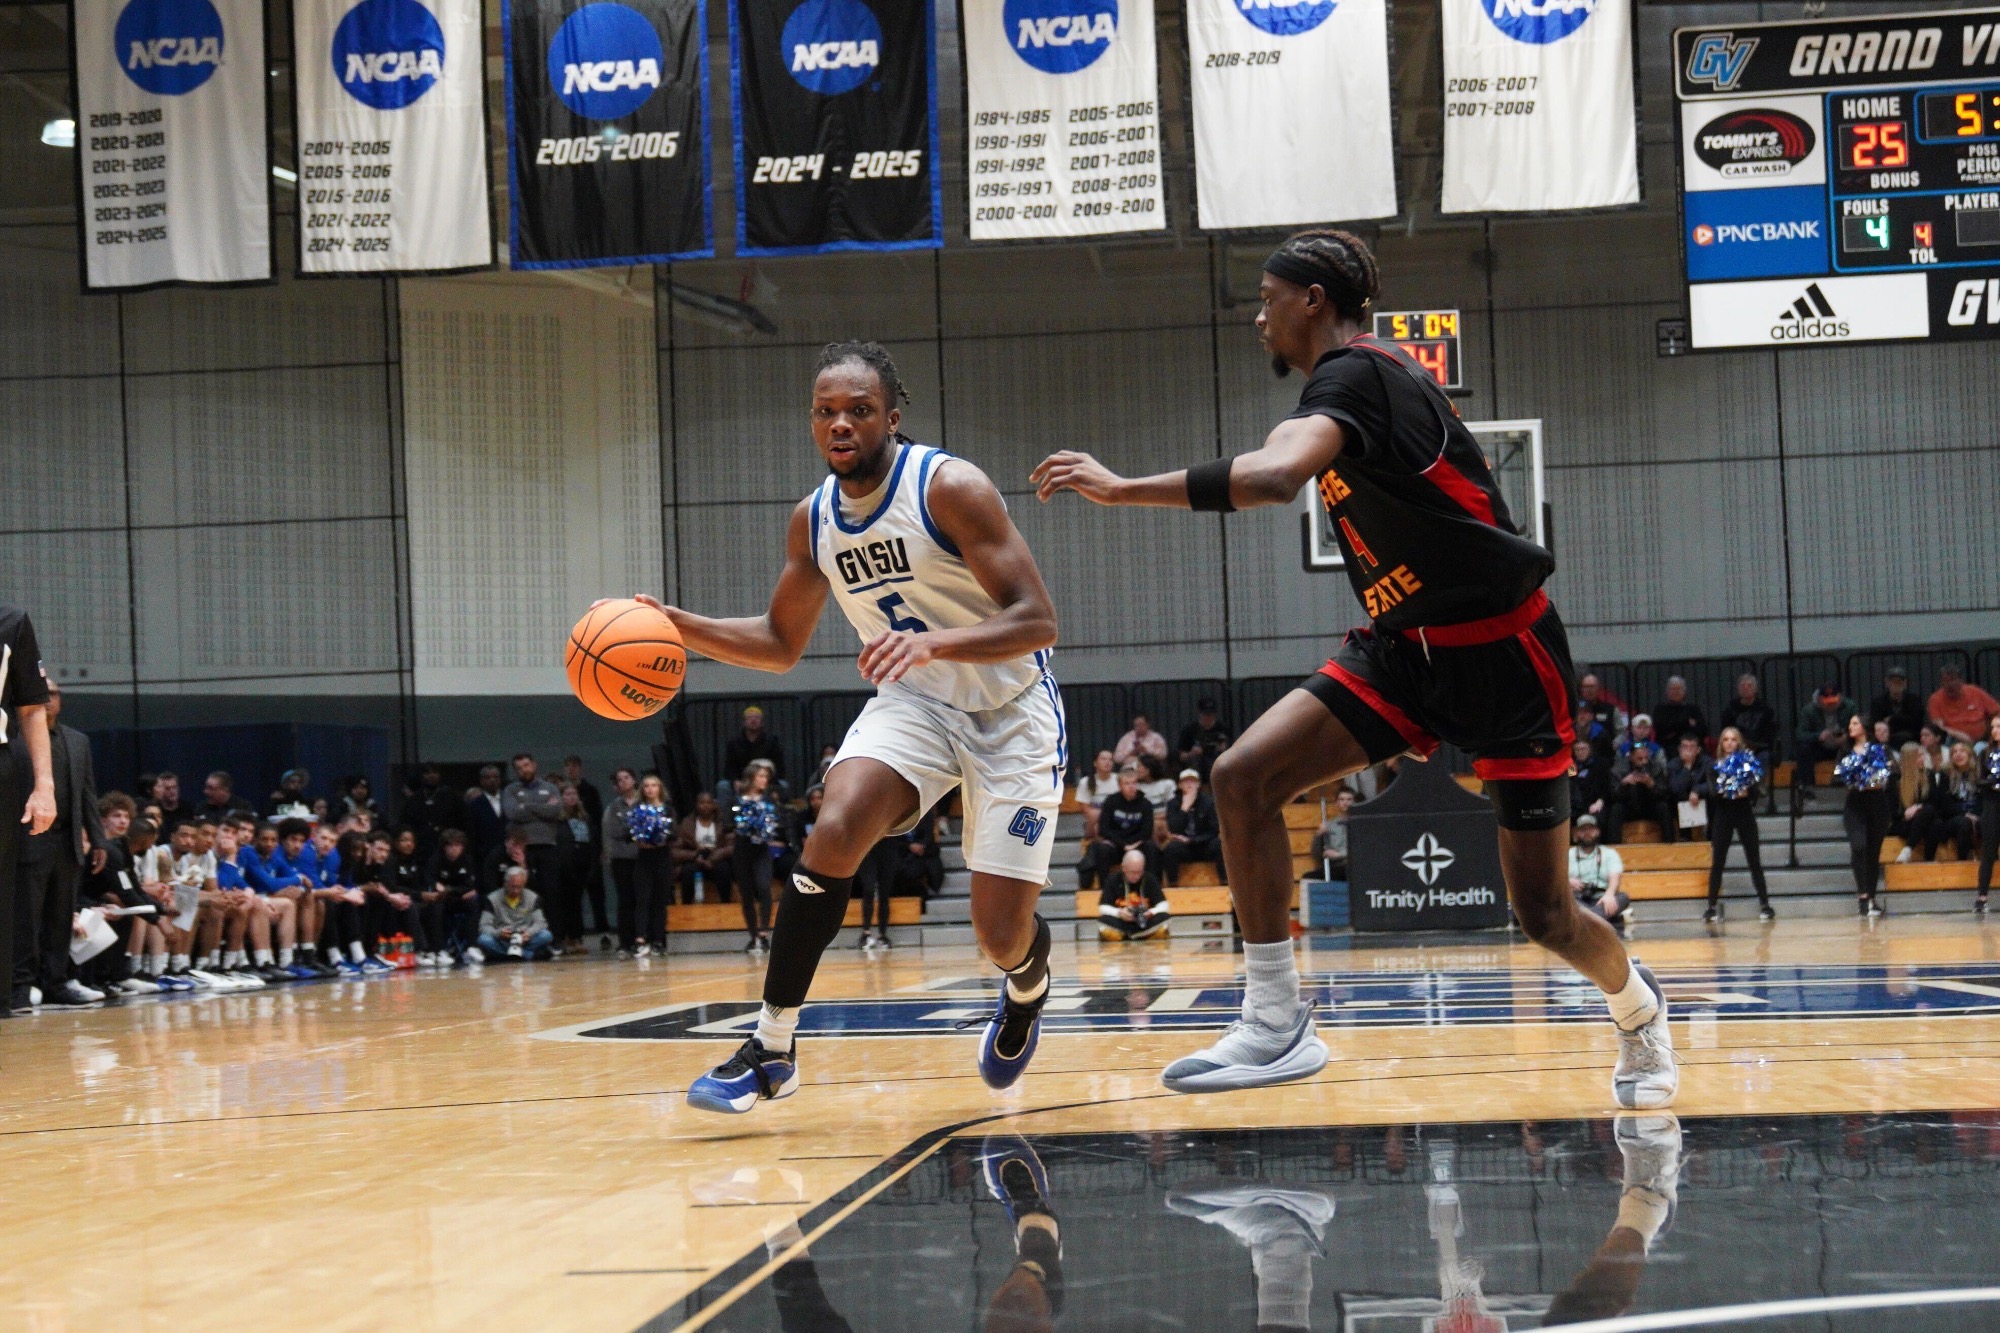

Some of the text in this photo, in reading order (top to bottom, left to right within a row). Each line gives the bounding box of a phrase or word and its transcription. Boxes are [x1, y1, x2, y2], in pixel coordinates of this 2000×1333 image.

[1017, 13, 1117, 49] NCAA
[128, 37, 220, 70] NCAA
[791, 40, 880, 72] NCAA
[1205, 50, 1281, 68] 2018-2019
[1686, 32, 1760, 91] GV
[1789, 27, 1943, 77] GRAND
[345, 49, 442, 84] NCAA
[563, 58, 662, 95] NCAA
[1447, 76, 1538, 93] 2006-2007
[974, 109, 1052, 126] 1984-1985
[1068, 101, 1154, 123] 2005-2006
[1447, 101, 1535, 117] 2007-2008
[1842, 96, 1901, 119] HOME
[974, 133, 1047, 150] 1990-1991
[1068, 125, 1155, 147] 2006-2007
[1702, 131, 1779, 150] TOMMY'S
[1852, 123, 1907, 167] 25
[304, 141, 391, 156] 2004-2005
[536, 131, 680, 165] 2005-2006
[1731, 144, 1784, 160] EXPRESS
[1968, 144, 1998, 157] POSS
[752, 154, 825, 184] 2024
[849, 149, 922, 181] 2025
[974, 157, 1046, 174] 1991-1992
[1069, 149, 1156, 171] 2007-2008
[1725, 163, 1786, 175] CAR WASH
[304, 164, 392, 180] 2005-2006
[1870, 170, 1920, 189] BONUS
[975, 181, 1052, 198] 1996-1997
[1071, 174, 1157, 195] 2008-2009
[306, 188, 392, 204] 2015-2016
[975, 204, 1058, 221] 2000-2001
[1072, 198, 1155, 218] 2009-2010
[1843, 198, 1889, 216] FOULS
[307, 213, 391, 229] 2021-2022
[1865, 215, 1889, 249] 4
[1915, 223, 1931, 248] 4
[307, 237, 392, 253] 2024-2025
[1908, 248, 1938, 264] TOL
[1392, 313, 1457, 338] 5:04
[1770, 318, 1850, 341] adidas
[835, 537, 911, 585] GVSU
[875, 591, 929, 633] 5
[652, 656, 685, 675] EVO
[1008, 806, 1047, 847] GV
[1365, 886, 1495, 912] Trinity Health
